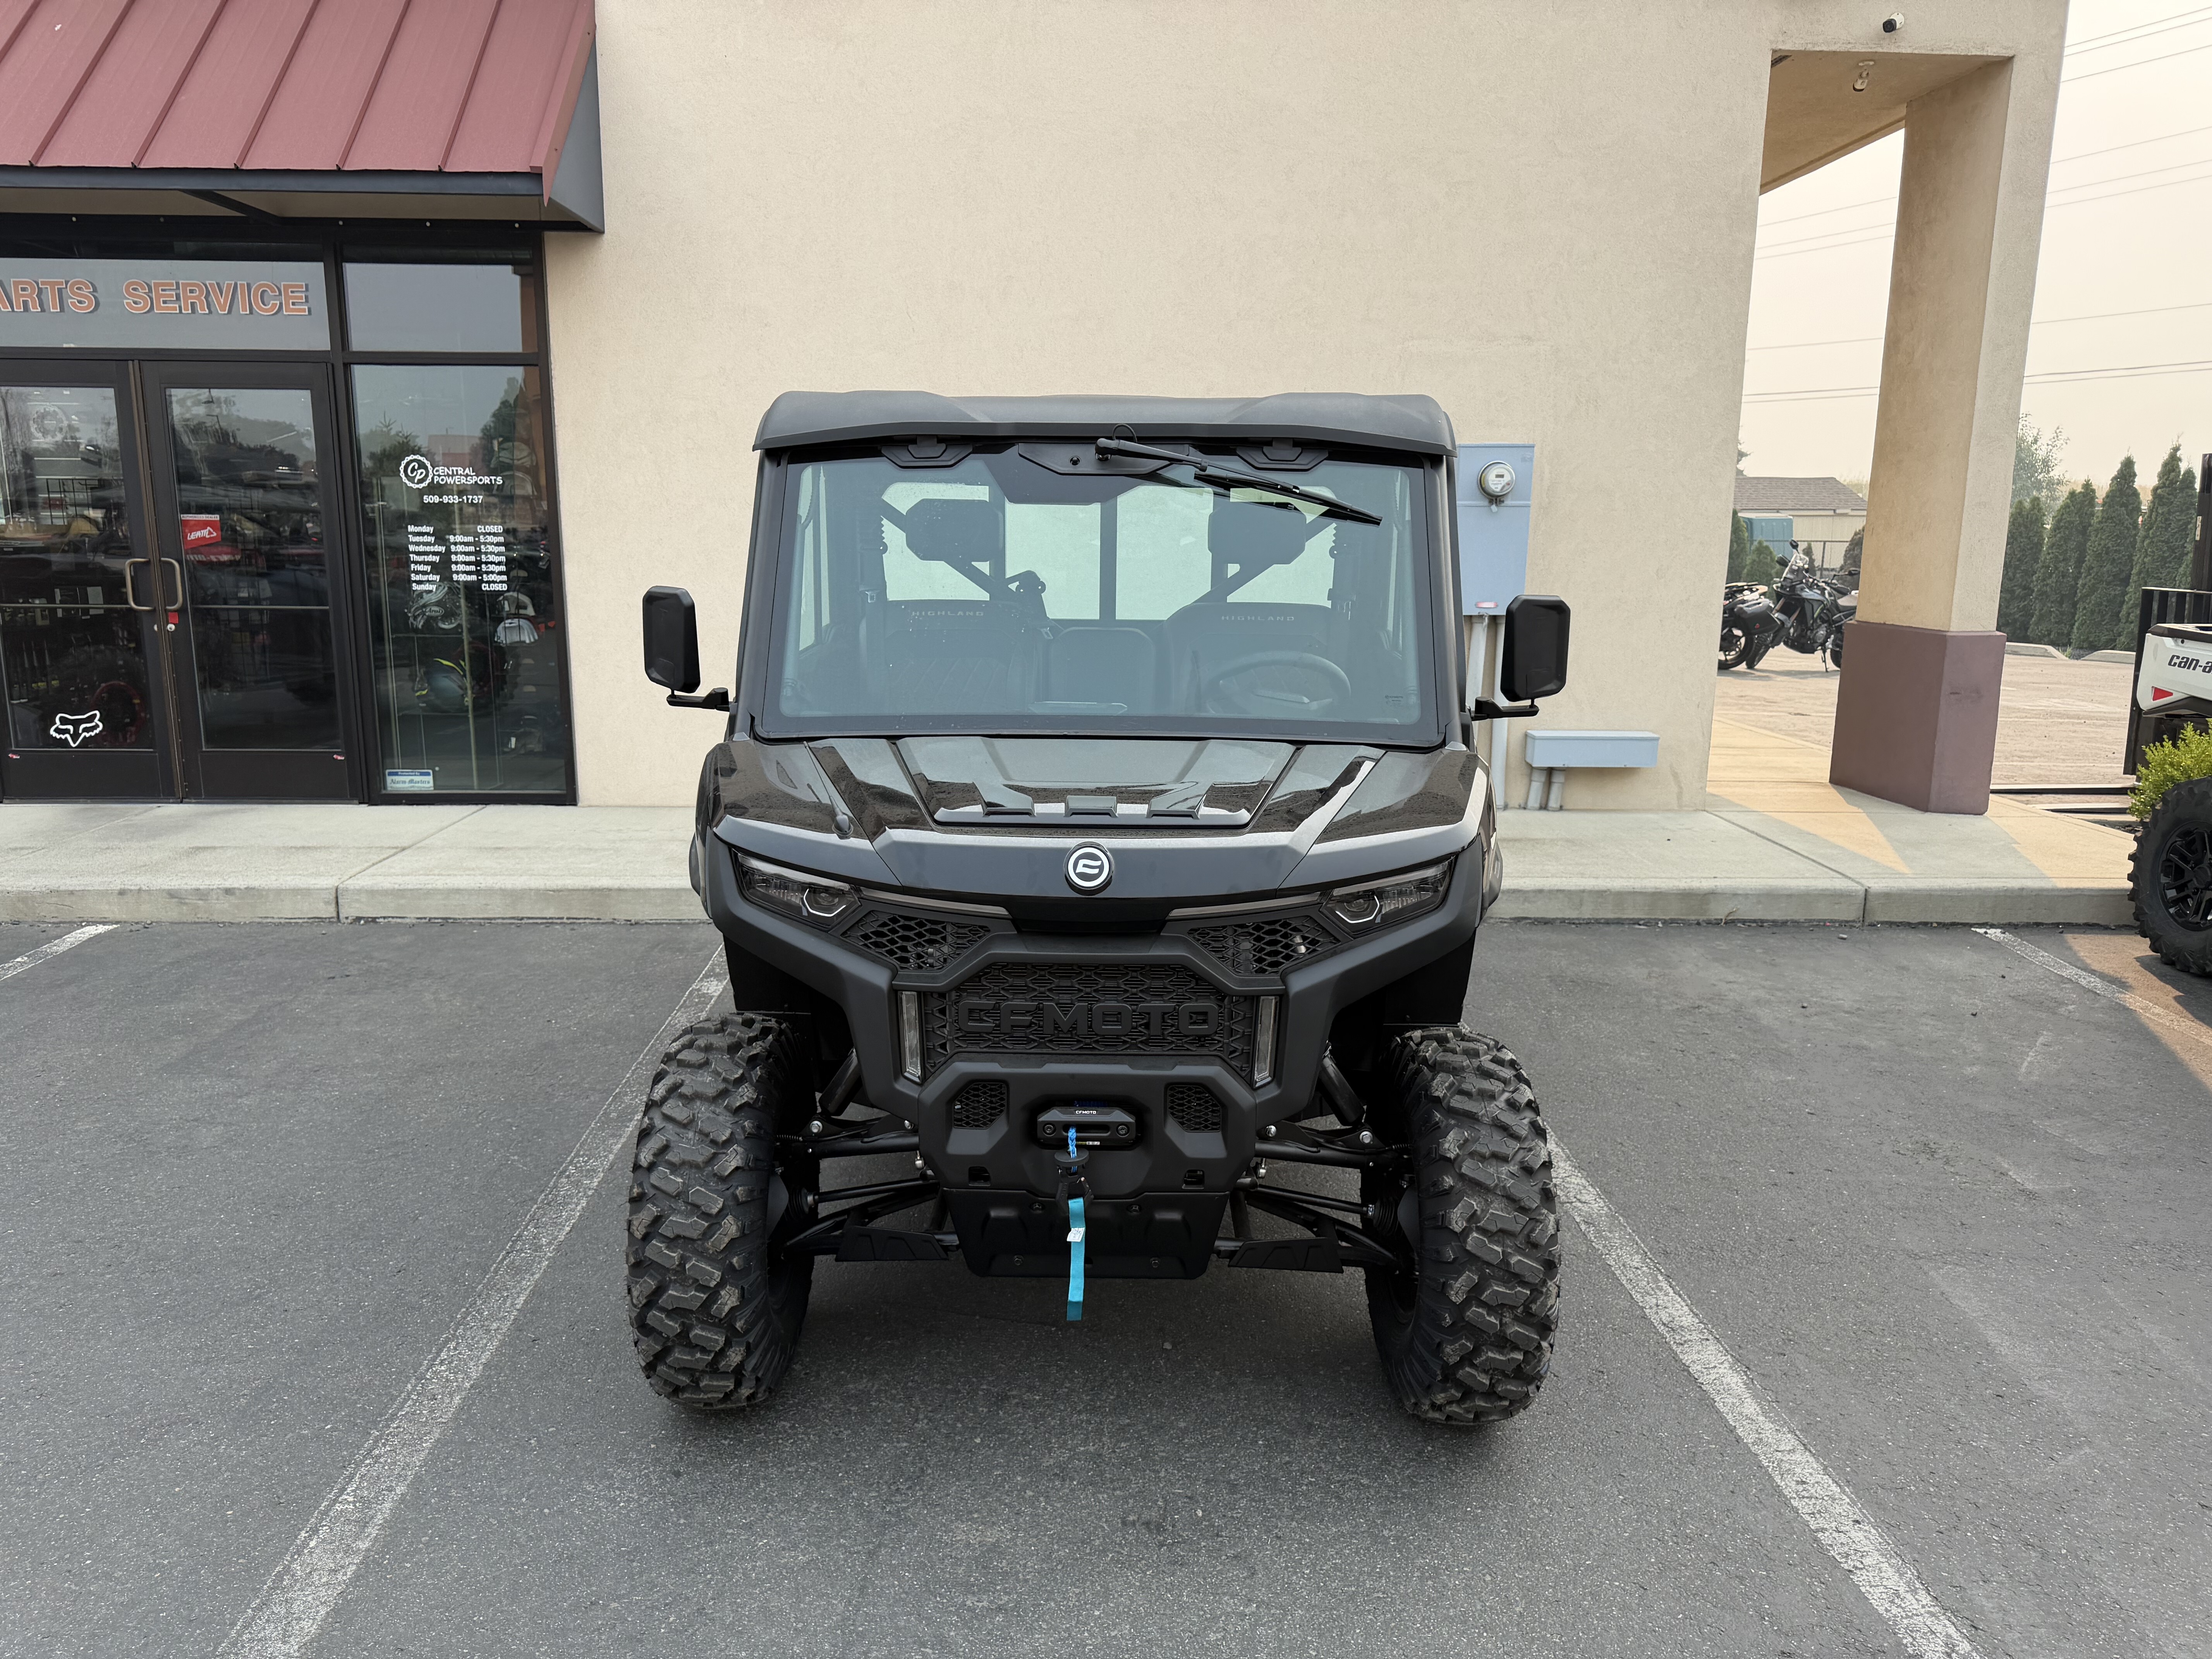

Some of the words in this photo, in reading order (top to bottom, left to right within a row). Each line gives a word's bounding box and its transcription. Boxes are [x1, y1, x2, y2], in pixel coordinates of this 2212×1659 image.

[123, 279, 309, 315] SERVICE
[433, 466, 476, 476] CENTRAL
[434, 476, 503, 484] POWERSPORTS
[423, 495, 483, 503] 509-933-1737
[408, 525, 434, 534] Monday
[408, 535, 435, 543] Tuesday
[480, 535, 504, 544] 5:30pm
[409, 544, 446, 553] Wednesday
[481, 545, 505, 553] 5:30pm
[409, 554, 440, 563] Thursday
[481, 555, 506, 563] 5:30pm
[411, 564, 431, 572] Friday
[481, 564, 506, 573] 5:30pm
[411, 574, 440, 582] Saturday
[483, 574, 507, 582] 5:00pm
[412, 583, 436, 592] Sunday
[2168, 654, 2212, 673] can-a
[958, 1000, 1218, 1035] CFMOTO
